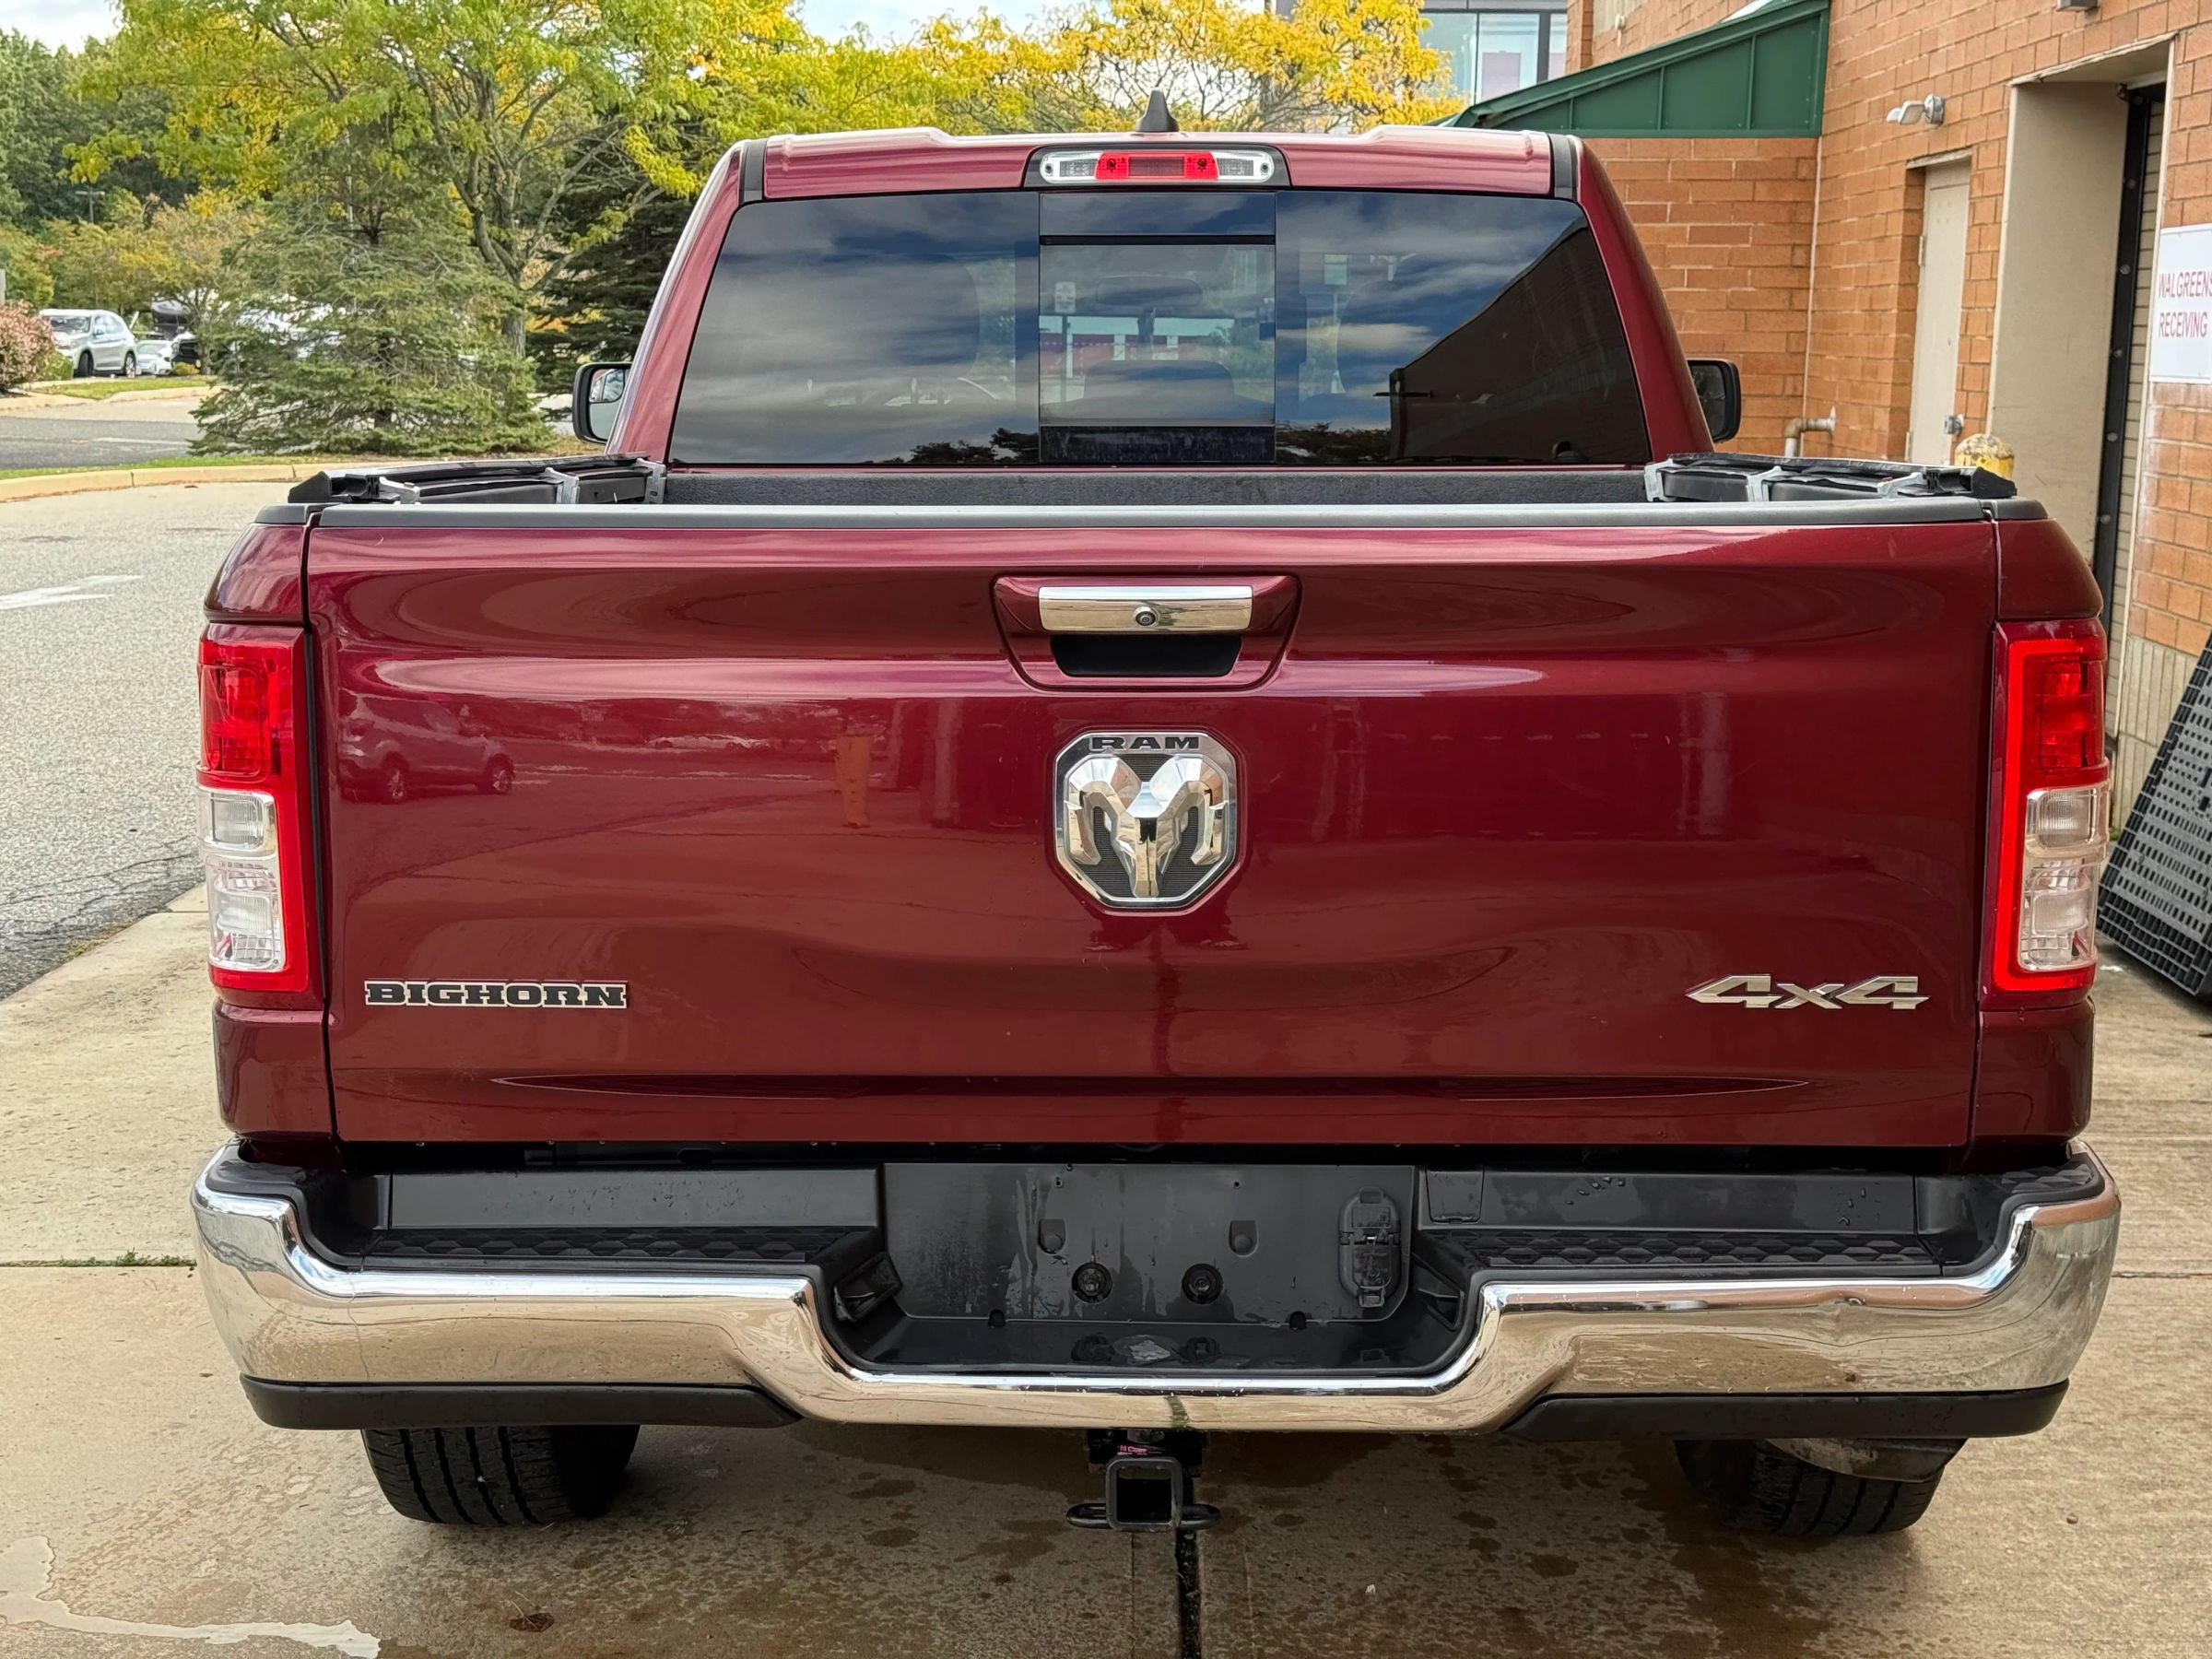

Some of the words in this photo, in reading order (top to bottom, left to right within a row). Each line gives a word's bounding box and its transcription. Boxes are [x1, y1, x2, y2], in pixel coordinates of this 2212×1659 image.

[2159, 312, 2208, 338] RECEIVING
[1091, 736, 1199, 750] RAM
[365, 980, 628, 1009] BIGHORN
[1686, 974, 1930, 1010] 4x4
